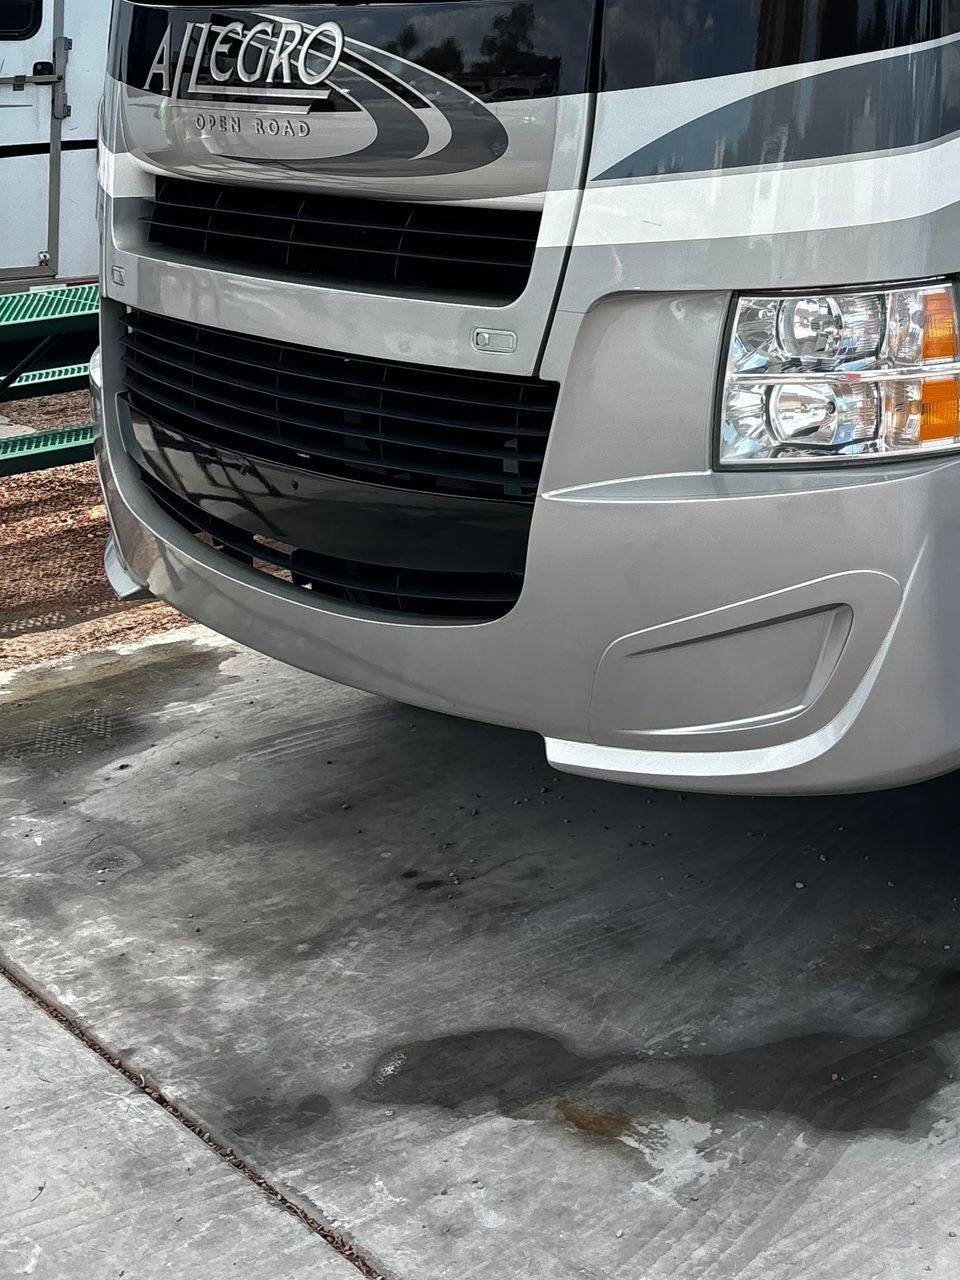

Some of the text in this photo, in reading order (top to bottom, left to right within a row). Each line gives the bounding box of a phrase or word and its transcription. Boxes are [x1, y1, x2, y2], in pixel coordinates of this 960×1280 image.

[143, 21, 345, 115] ALLEGRO
[196, 113, 311, 138] OPEN ROAD
